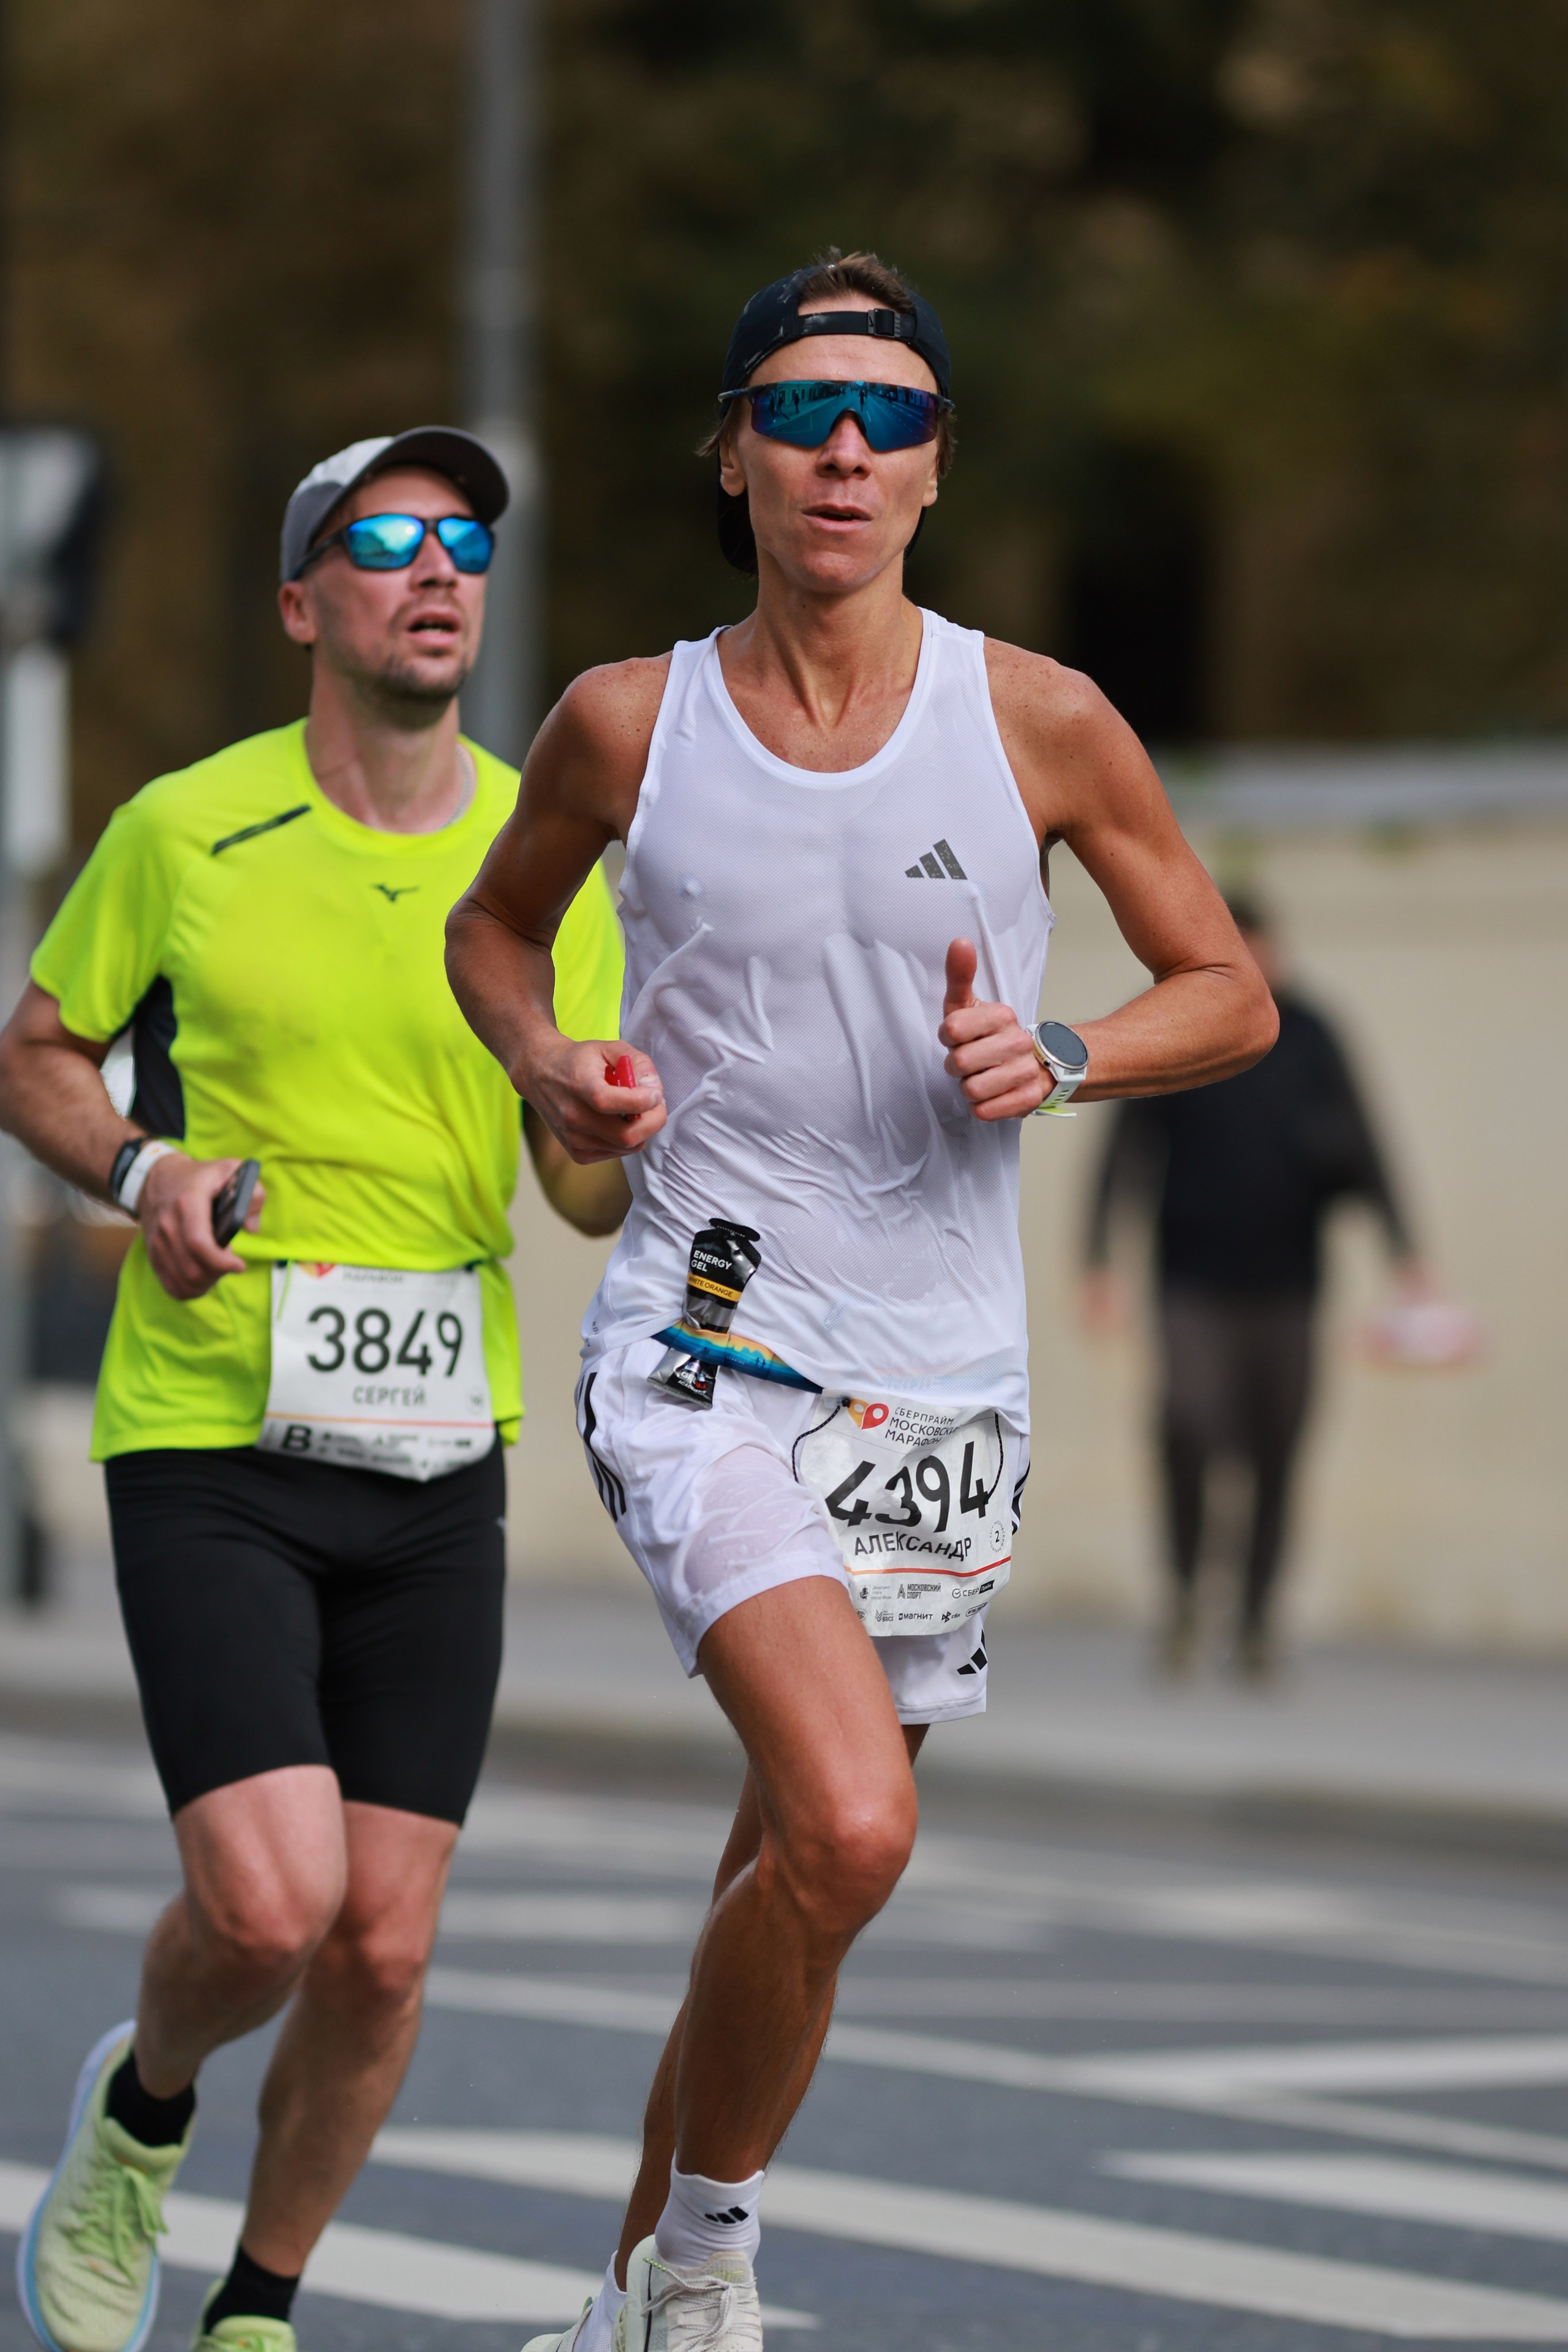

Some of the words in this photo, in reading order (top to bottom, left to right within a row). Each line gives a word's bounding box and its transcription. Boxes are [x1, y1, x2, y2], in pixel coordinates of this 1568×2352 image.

[691, 1259, 707, 1272] GEL
[693, 1250, 733, 1270] ENERGY
[704, 1282, 733, 1297] ORANGE
[306, 1305, 464, 1378] 3849
[352, 1384, 427, 1406] СЕРГЕЙ
[894, 1407, 954, 1425] СБЕРПРАЙМ
[884, 1429, 943, 1446] МАРАФОН
[824, 1441, 989, 1533] 4394
[995, 1530, 1000, 1544] 2
[854, 1531, 972, 1561] АЛЕКСАНДР
[907, 1583, 941, 1593] МОСКОВСКИЙ
[963, 1588, 979, 1597] СБЕР
[903, 1612, 933, 1621] магнит
